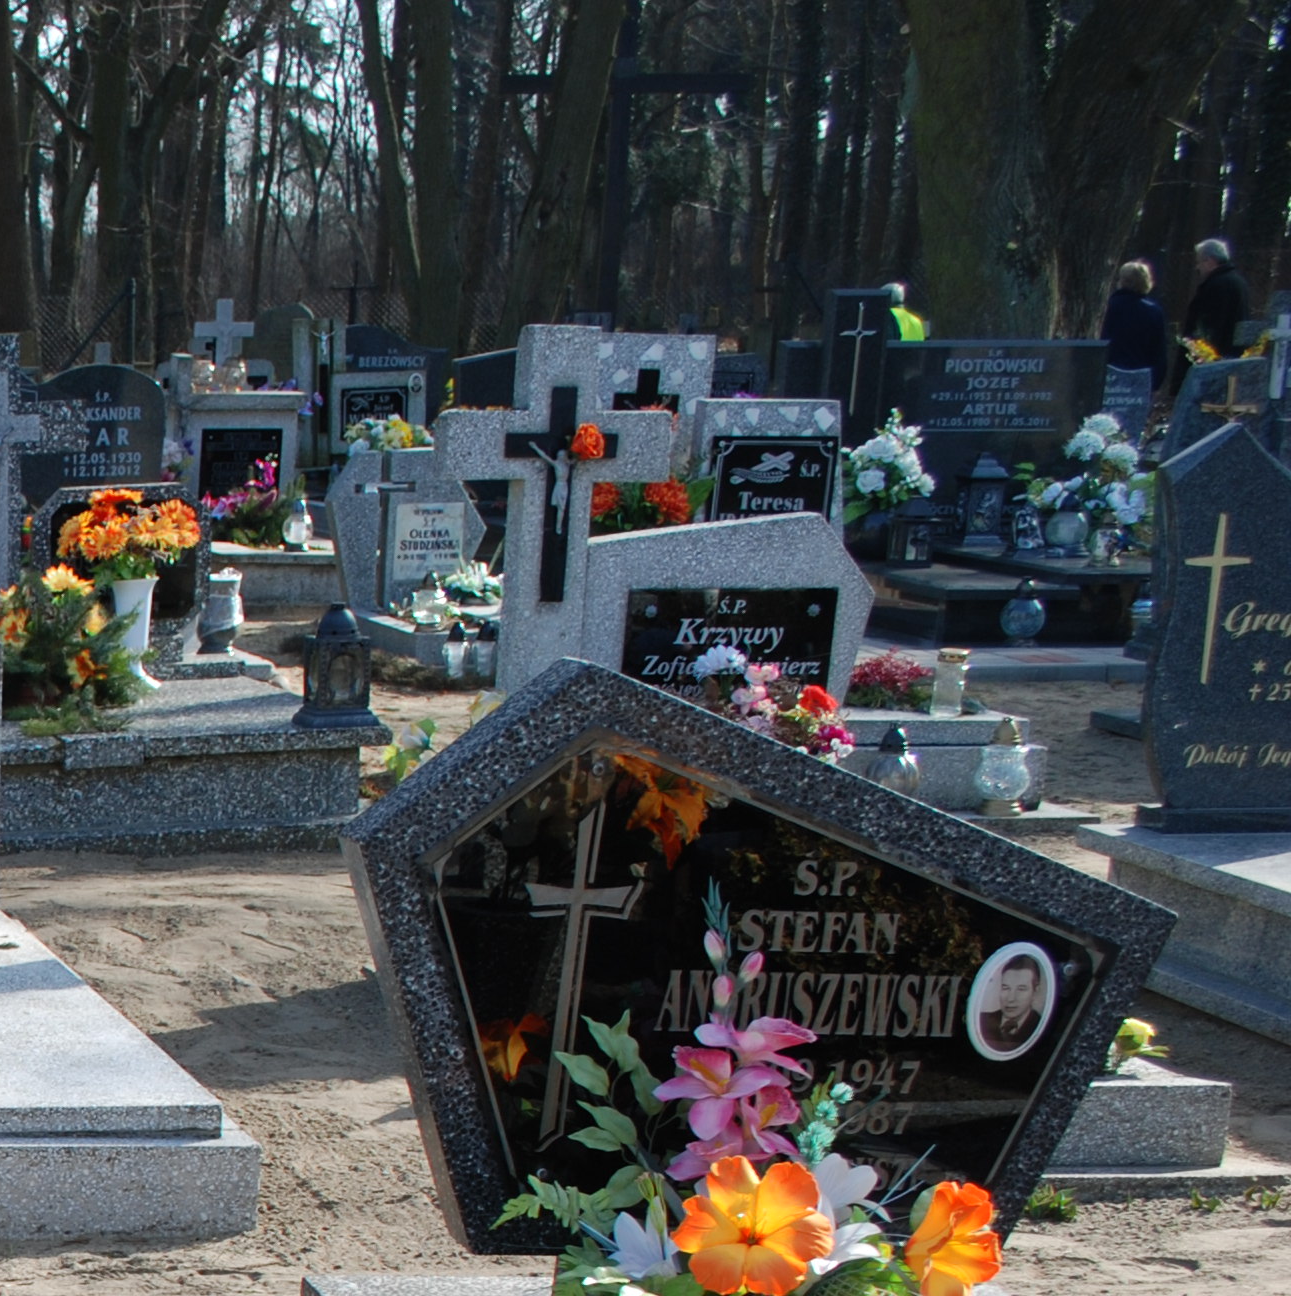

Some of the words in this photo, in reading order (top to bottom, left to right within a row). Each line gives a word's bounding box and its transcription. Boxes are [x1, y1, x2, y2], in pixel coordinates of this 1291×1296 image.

[944, 358, 1045, 374] PIOTROWSKI
[966, 374, 1021, 391] JÓZEF
[961, 403, 1018, 416] ARTUR
[738, 491, 805, 512] Teresa
[717, 595, 748, 615] Ś.P.
[672, 617, 785, 654] Krzywy
[1182, 742, 1251, 768] Pokój
[736, 908, 901, 955] STEFAN
